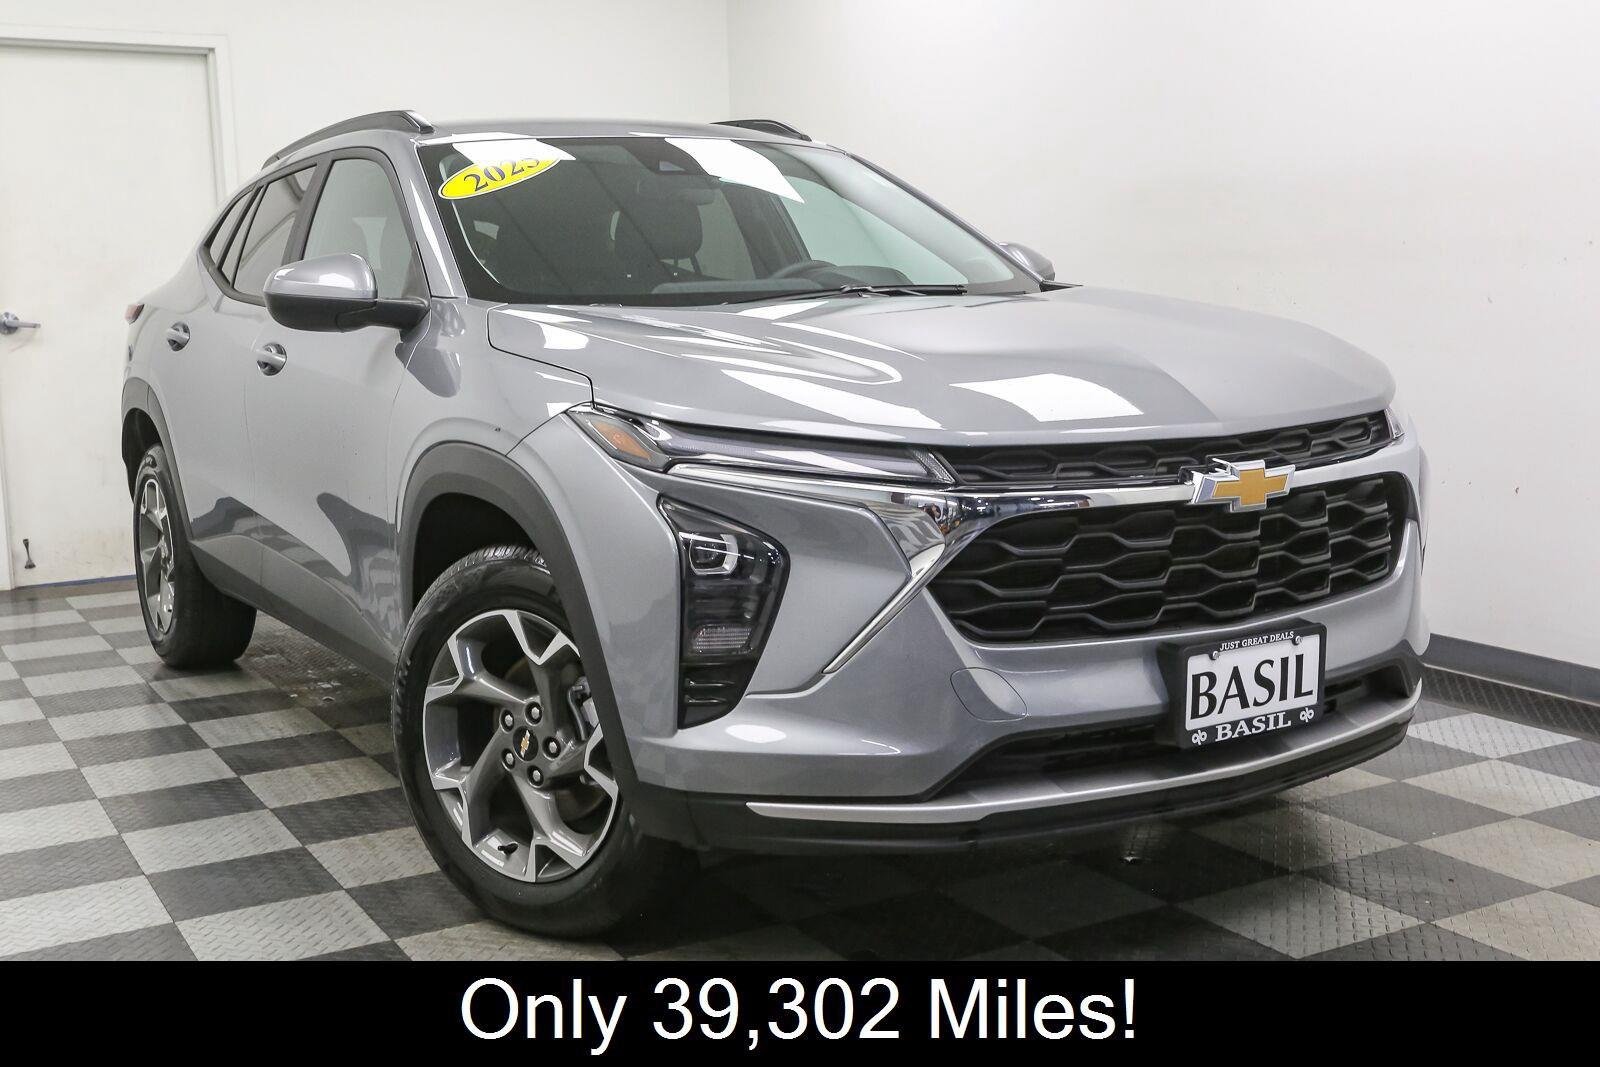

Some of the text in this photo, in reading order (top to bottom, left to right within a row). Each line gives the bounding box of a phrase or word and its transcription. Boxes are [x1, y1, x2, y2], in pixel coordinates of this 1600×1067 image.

[1219, 630, 1295, 652] JUST GREAT DEALS
[1190, 653, 1314, 721] BASIL
[1214, 711, 1292, 743] BASIL
